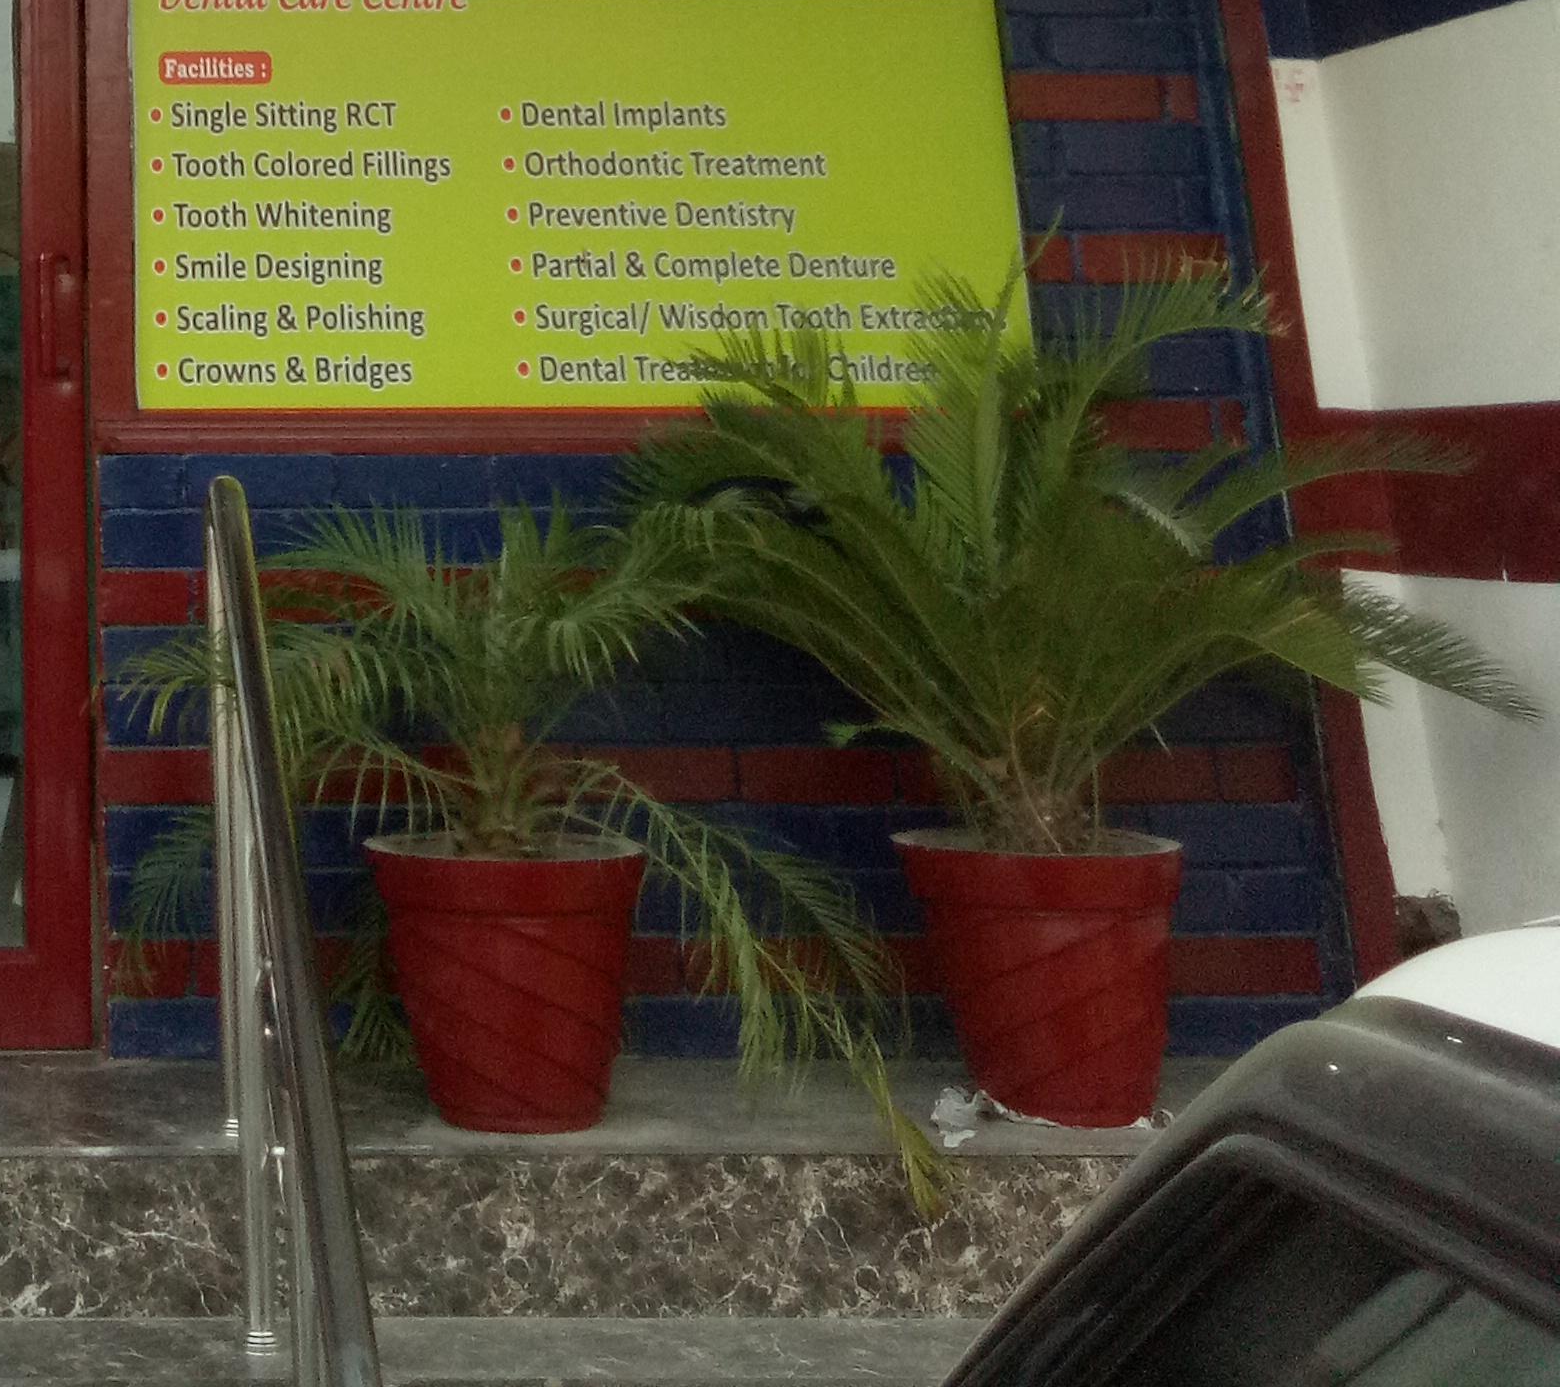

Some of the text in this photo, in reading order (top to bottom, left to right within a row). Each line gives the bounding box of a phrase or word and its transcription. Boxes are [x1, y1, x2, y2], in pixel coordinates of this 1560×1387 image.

[164, 57, 255, 79] Facilities
[171, 102, 397, 133] Single Sitting RCT
[521, 102, 726, 131] Dental Implants
[172, 151, 451, 182] Tooth Colored Fillings
[524, 151, 826, 177] Orthodontic Treatment
[174, 202, 391, 233] Tooth Whitening
[529, 201, 795, 233] Preventive Dentistry
[175, 252, 383, 284] Smile Designing
[531, 251, 896, 283] Partial & Complete Denture
[176, 304, 425, 336] Scaling & Polishing
[535, 303, 650, 334] Surgical/
[659, 303, 767, 330] Wisdom
[776, 304, 850, 330] Tooth
[178, 356, 413, 388] Crowns & Bridges
[540, 356, 627, 382] Dental
